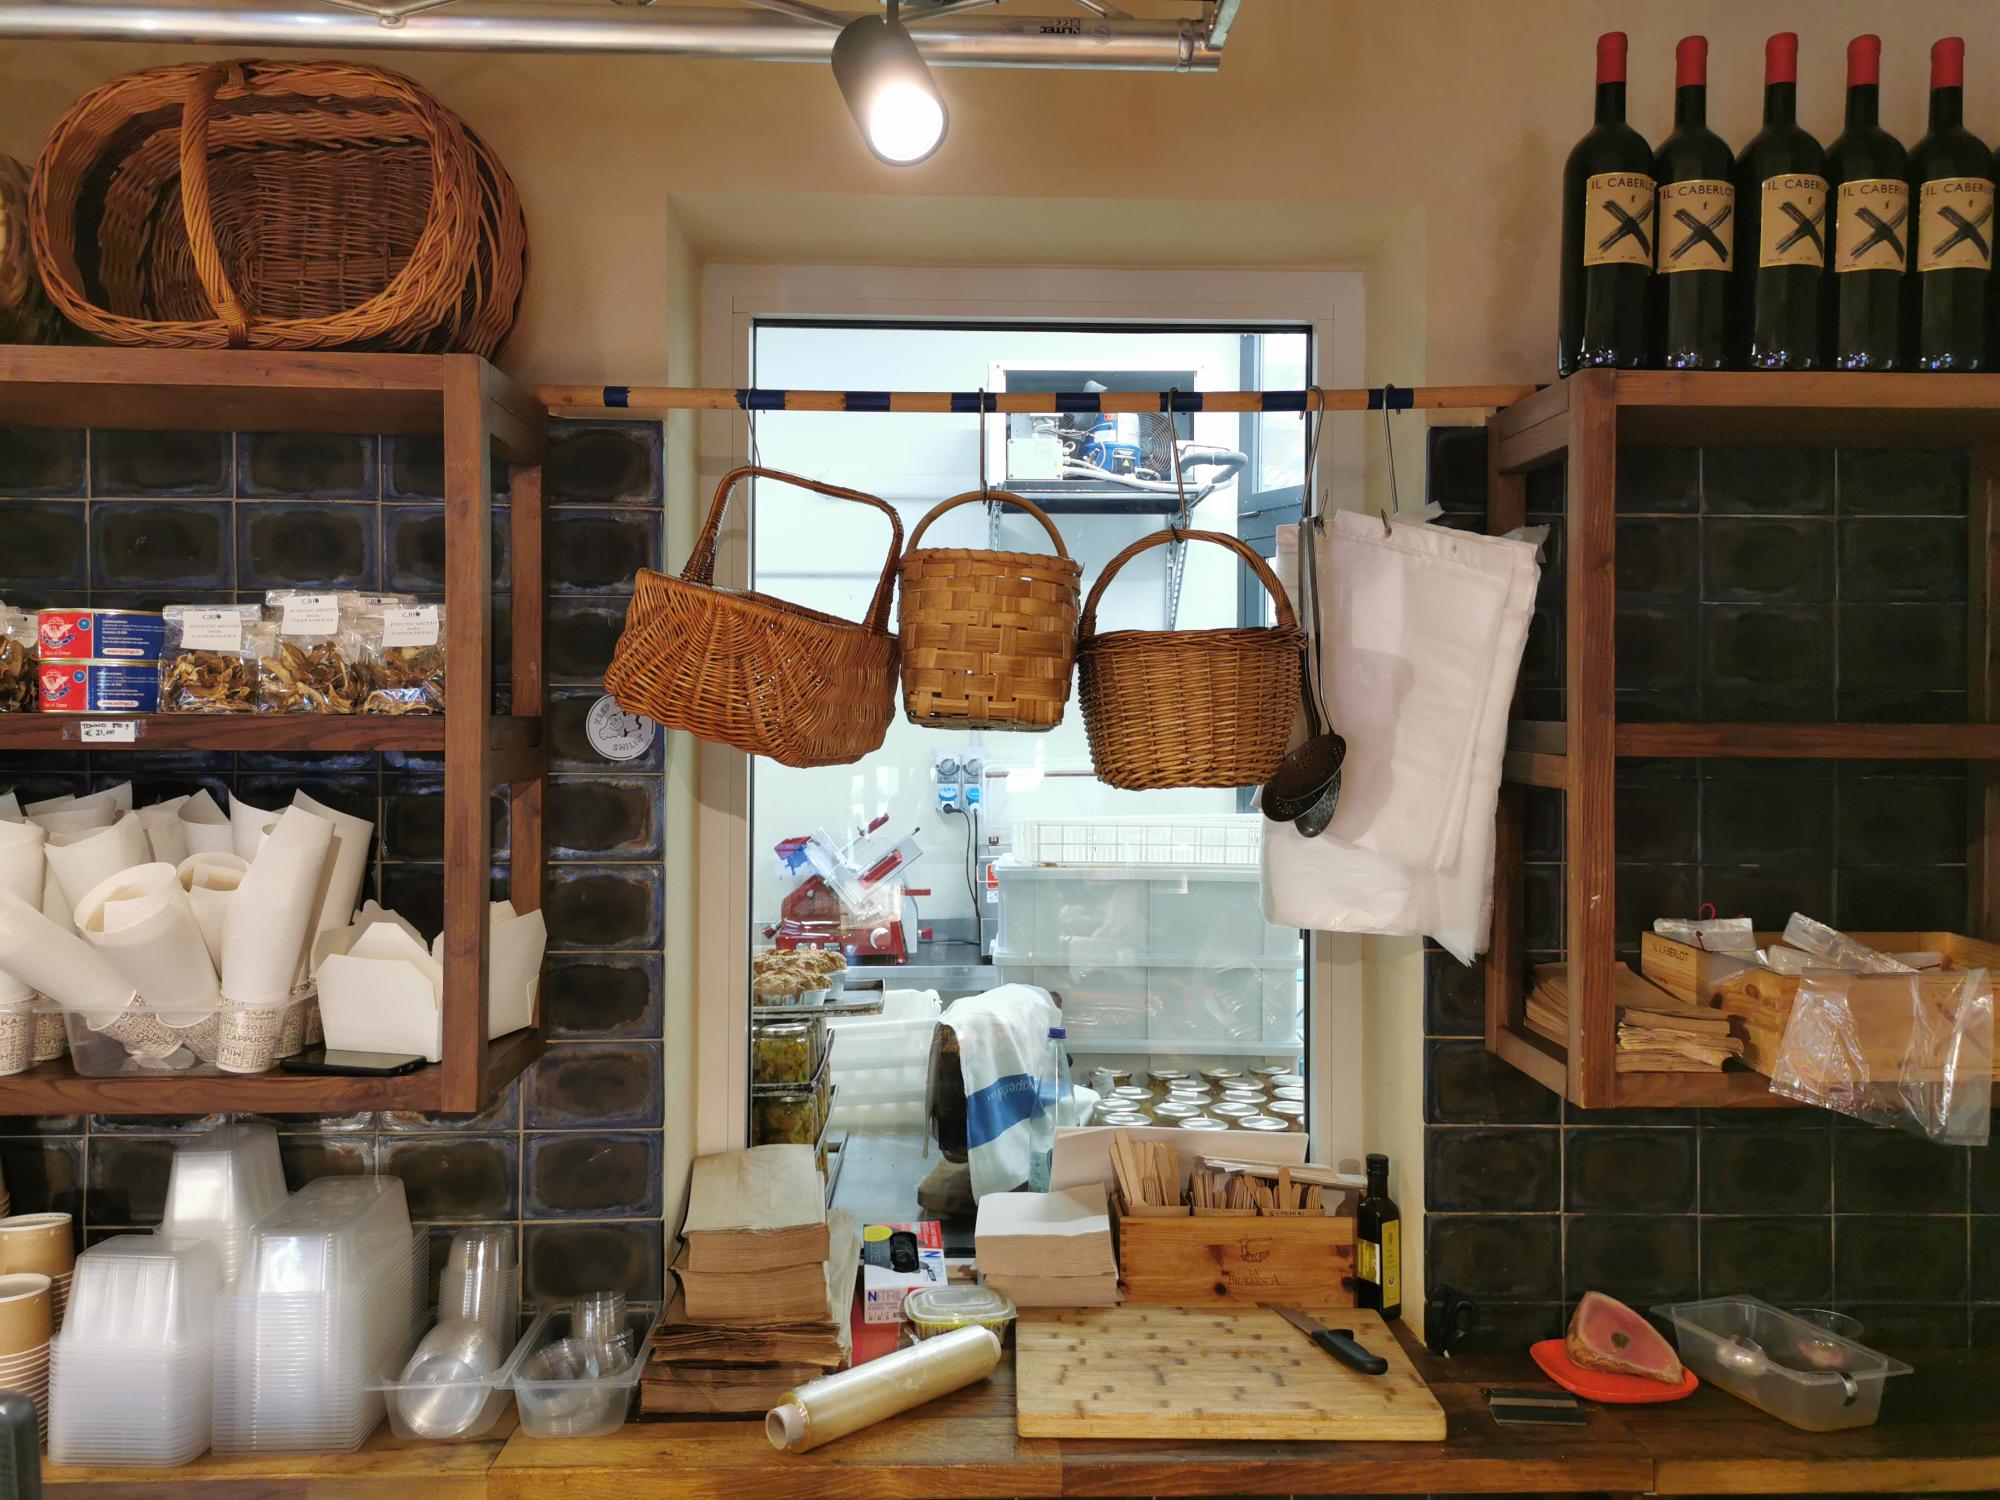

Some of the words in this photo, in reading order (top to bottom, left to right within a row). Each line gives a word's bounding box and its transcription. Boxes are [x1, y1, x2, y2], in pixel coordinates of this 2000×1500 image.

[1591, 180, 1602, 190] IL
[1767, 181, 1779, 191] IL
[1663, 189, 1673, 200] IL
[1843, 187, 1854, 197] IL
[1926, 186, 1938, 196] IL
